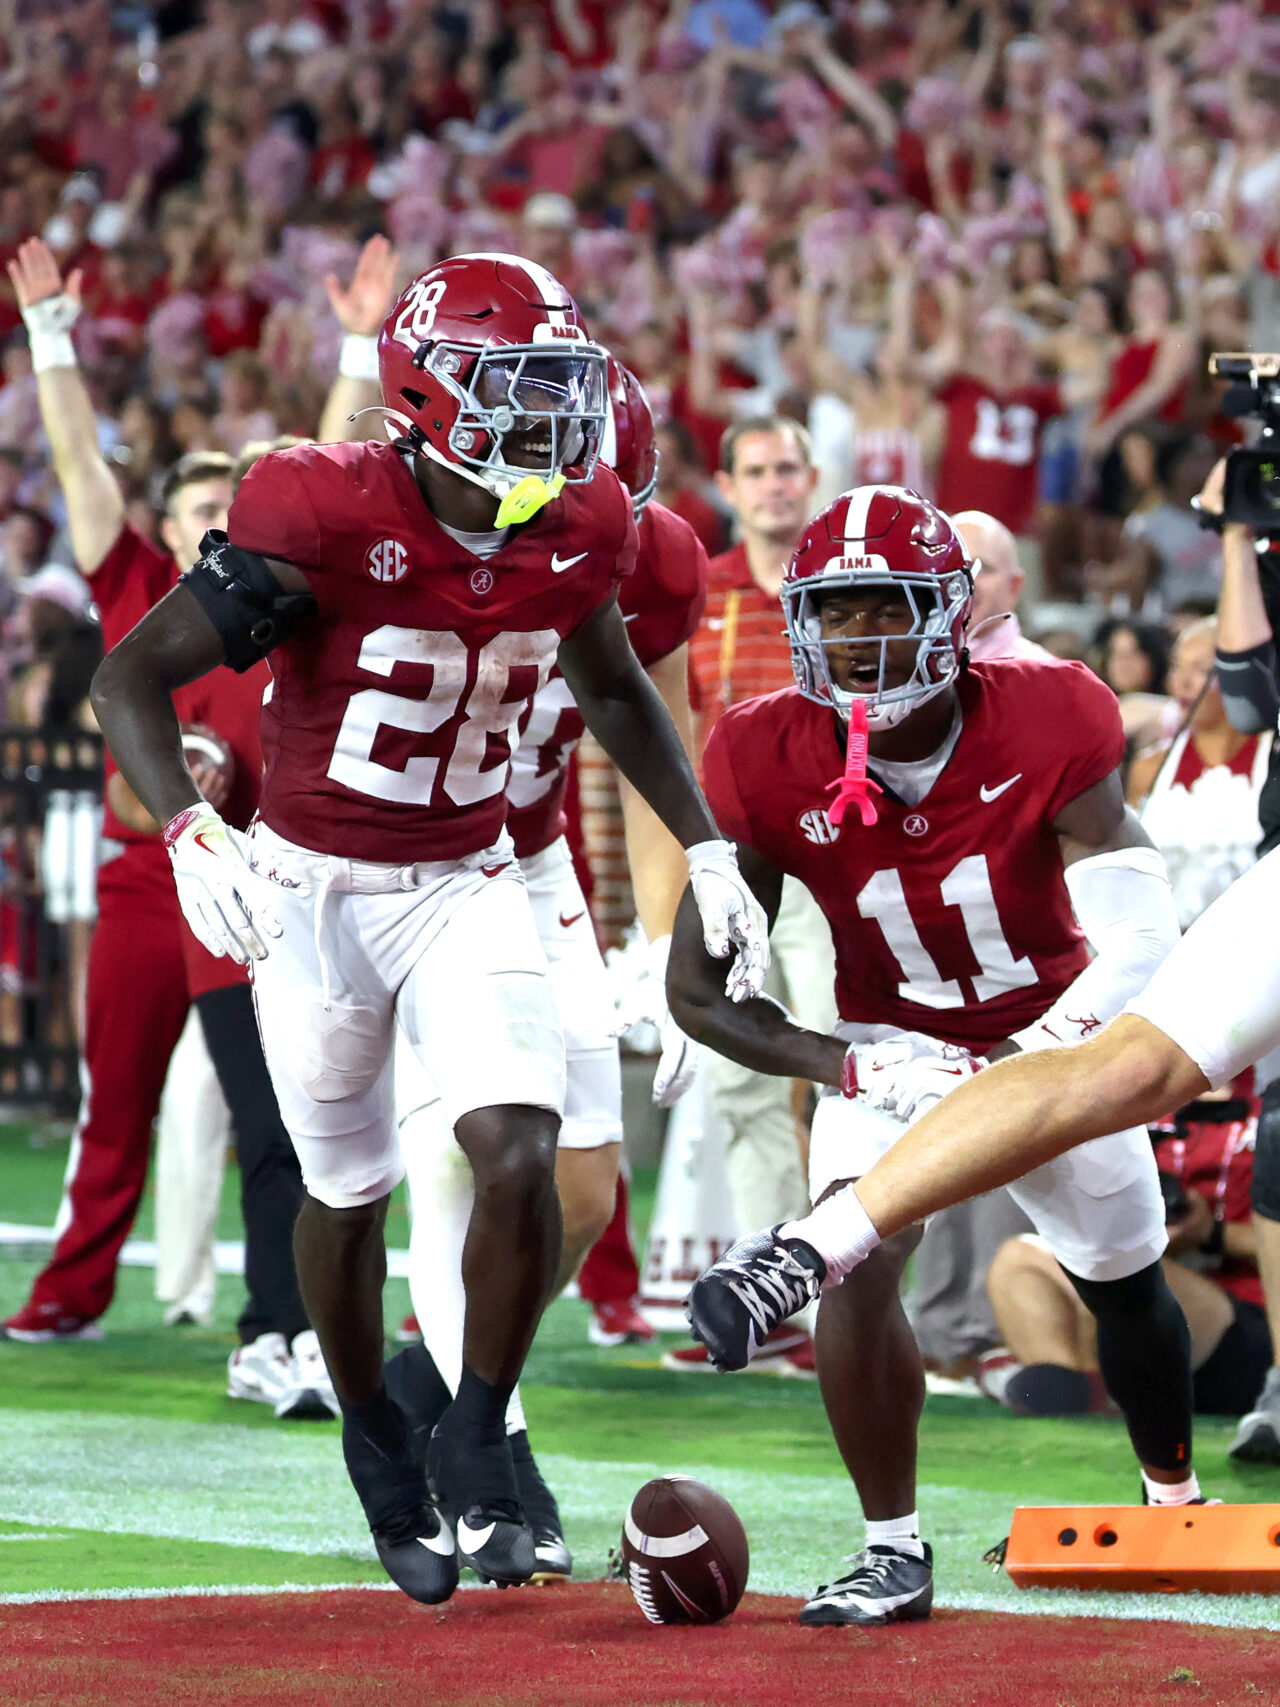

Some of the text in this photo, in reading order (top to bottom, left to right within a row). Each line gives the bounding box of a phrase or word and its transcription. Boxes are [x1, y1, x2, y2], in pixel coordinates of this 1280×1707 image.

[393, 280, 447, 337] 28
[551, 326, 580, 339] BAMA
[368, 539, 408, 582] SEC
[839, 557, 873, 570] BAMA
[326, 624, 562, 806] 28
[848, 733, 866, 771] NXTRND
[856, 854, 1040, 1010] 11
